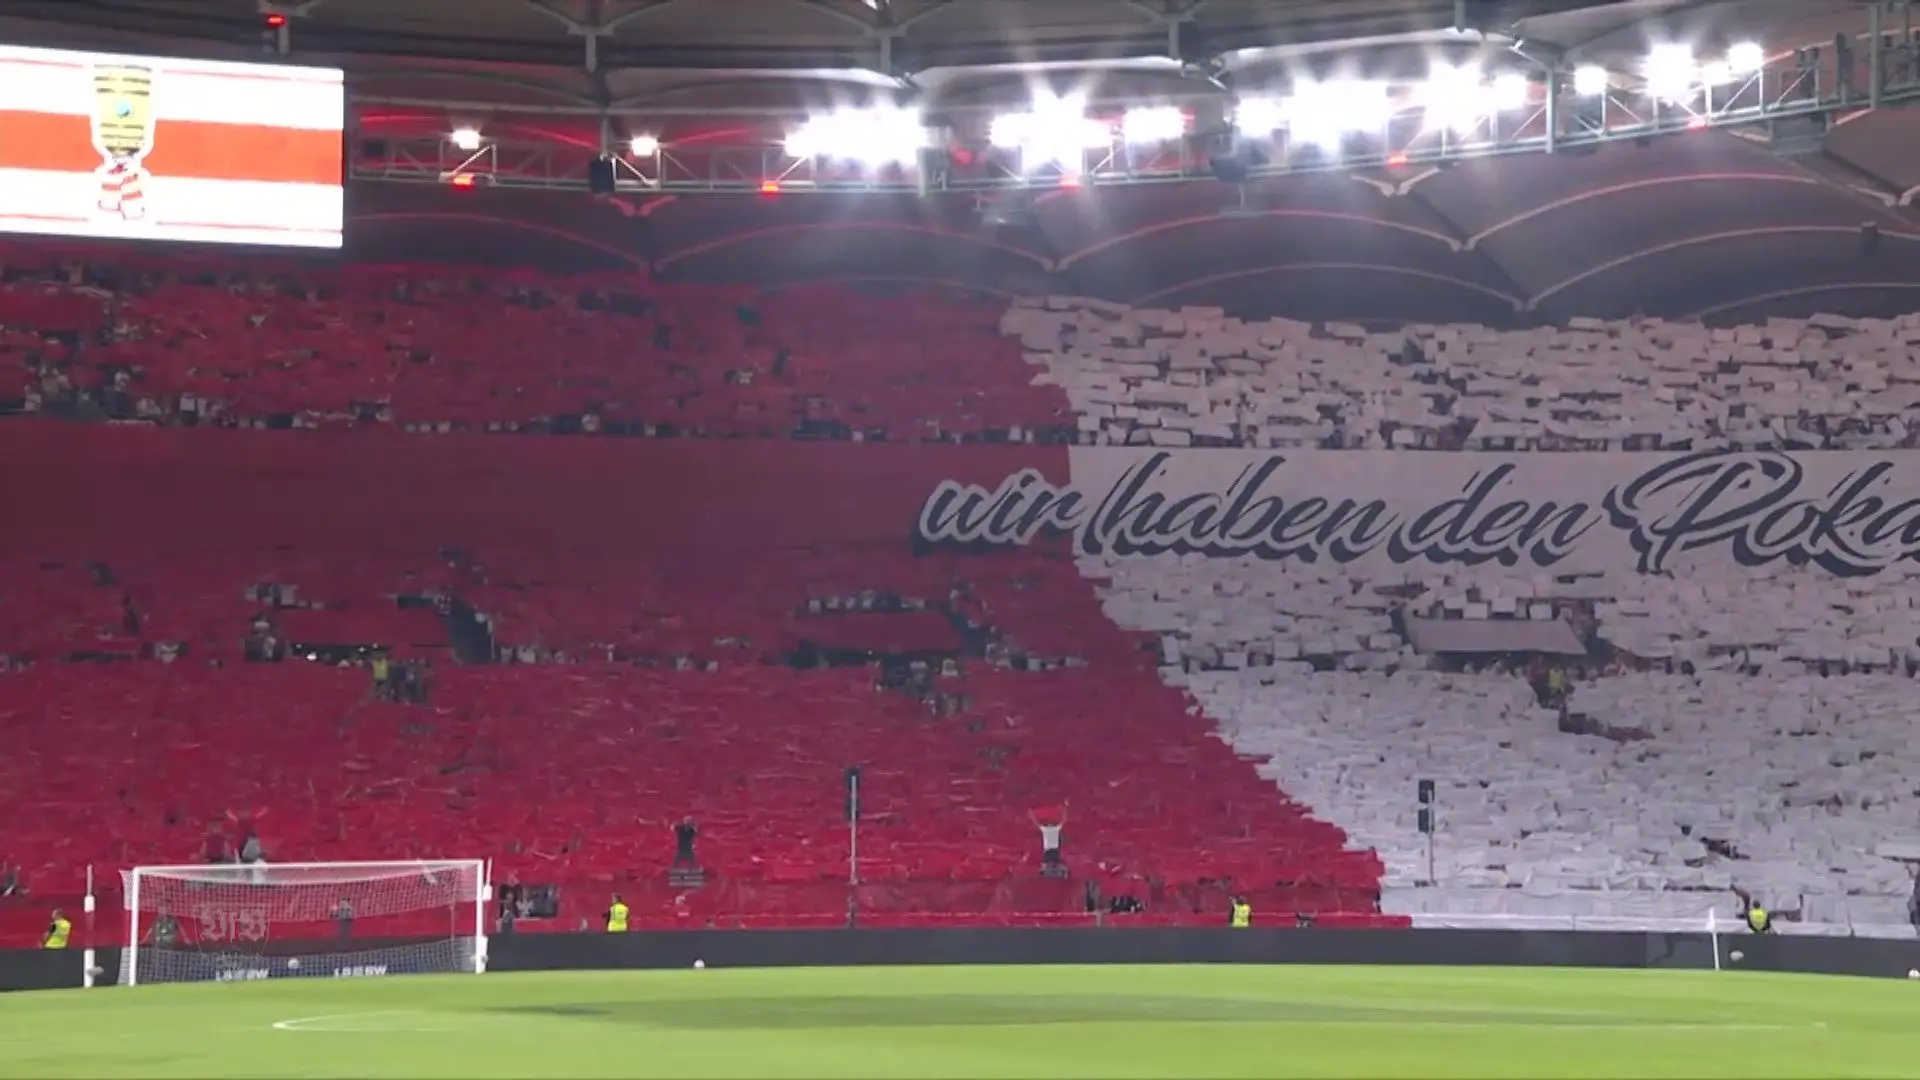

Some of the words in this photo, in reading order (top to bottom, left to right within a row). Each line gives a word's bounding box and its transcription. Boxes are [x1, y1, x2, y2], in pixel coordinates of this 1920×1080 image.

[917, 469, 1086, 550] wir
[1082, 451, 1399, 563] haben
[1387, 463, 1602, 567] den
